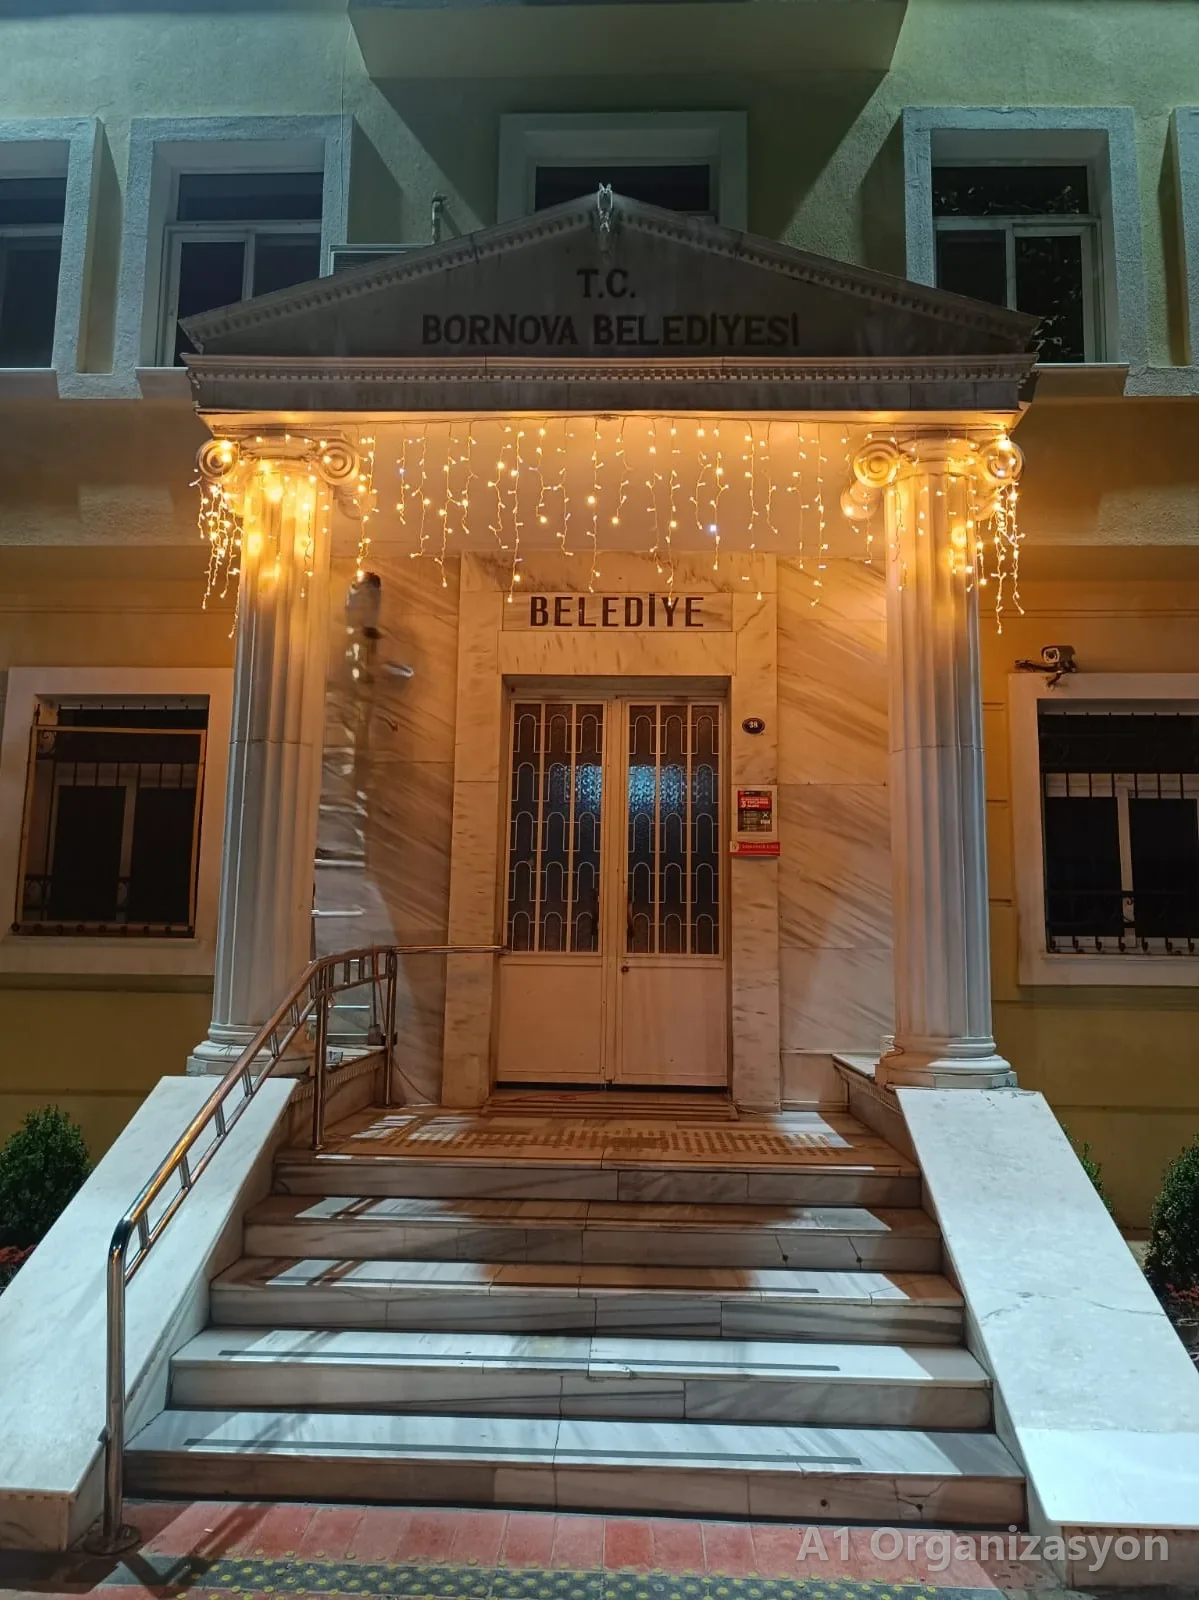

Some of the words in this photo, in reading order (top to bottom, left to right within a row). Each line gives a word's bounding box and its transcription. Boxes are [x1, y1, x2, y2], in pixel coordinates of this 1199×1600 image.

[577, 268, 635, 298] T.C.
[422, 313, 578, 345] BORNOVA
[530, 593, 704, 627] BELEDİYE
